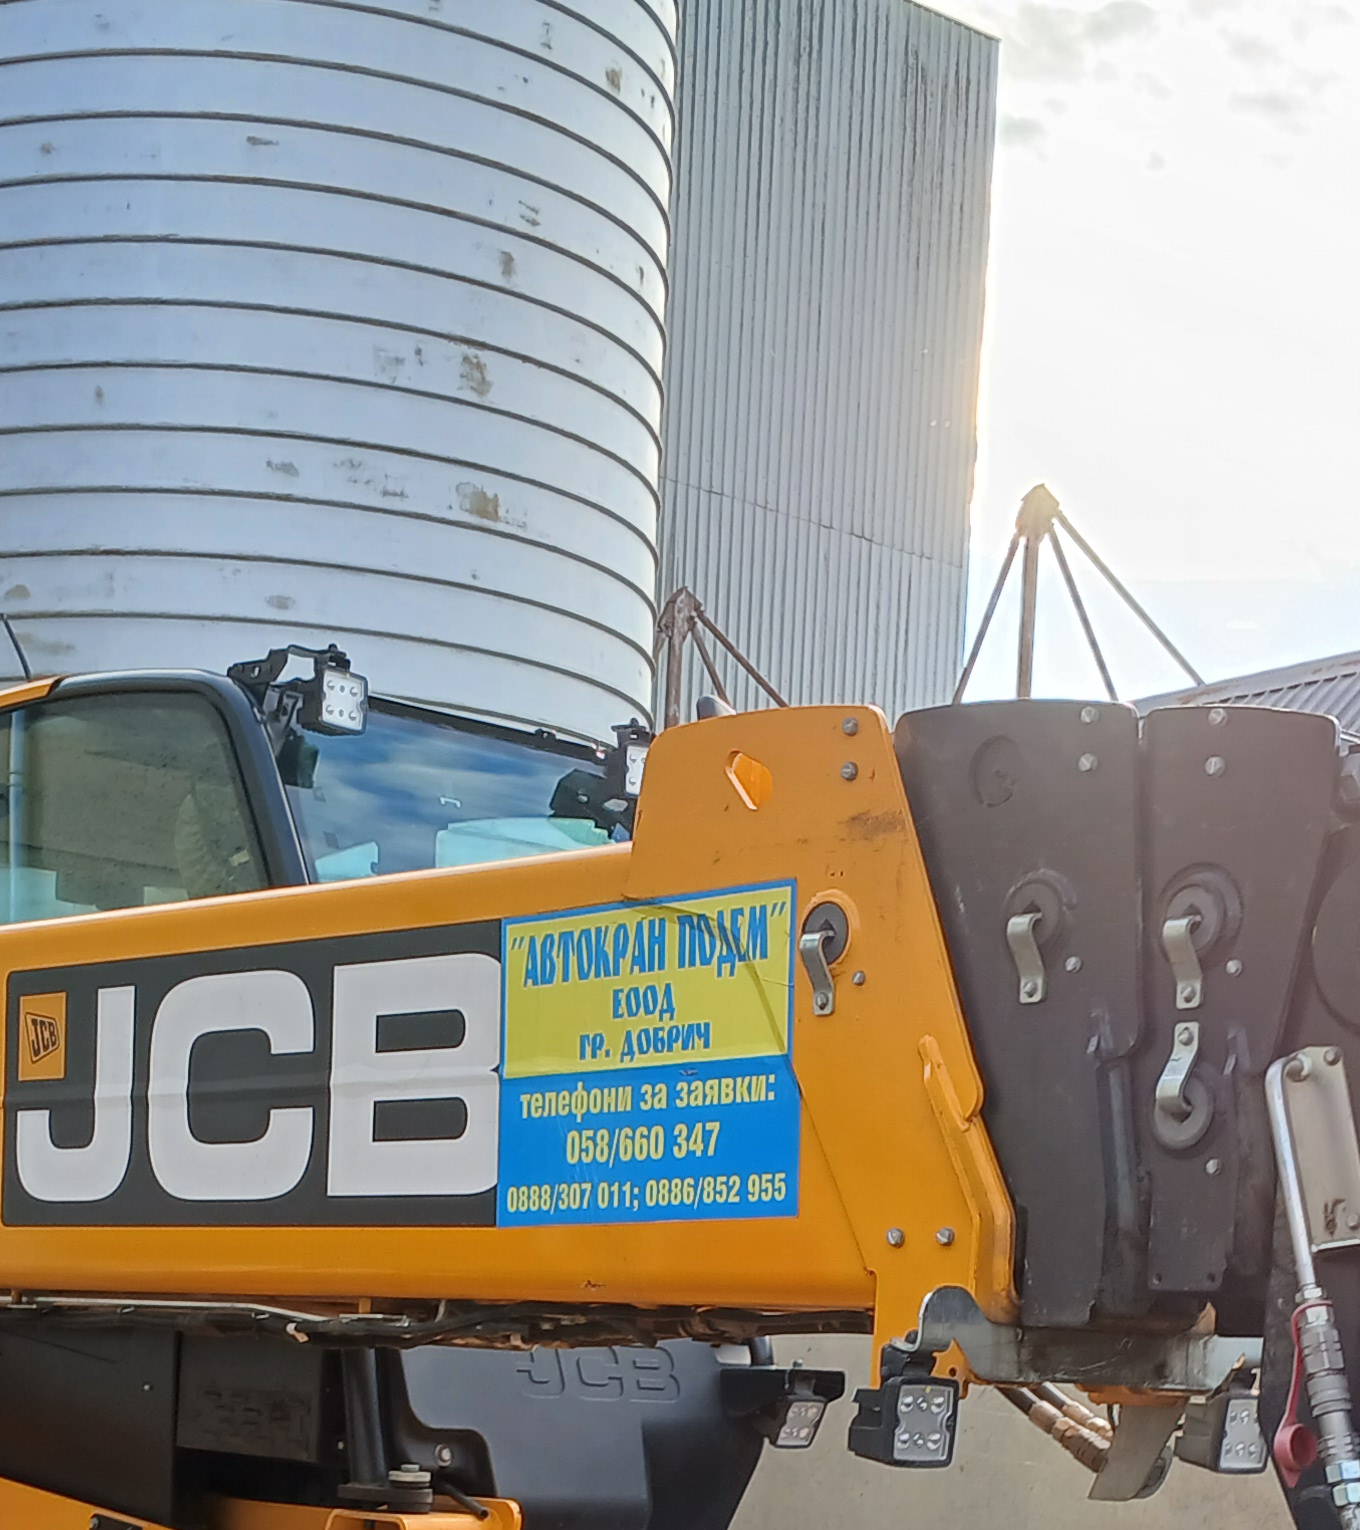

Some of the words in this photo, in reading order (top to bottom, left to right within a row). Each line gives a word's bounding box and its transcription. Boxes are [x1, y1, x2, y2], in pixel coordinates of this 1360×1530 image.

[612, 982, 676, 1022] ЕООД
[30, 1018, 58, 1058] JCB
[579, 1033, 611, 1061] ГР.
[619, 1021, 711, 1063] ДОБРИЧ
[16, 952, 501, 1202] JCB
[520, 1081, 633, 1122] телефони
[640, 1083, 668, 1110] за
[675, 1073, 776, 1108] заявки:
[566, 1125, 665, 1168] 058/660
[673, 1121, 721, 1158] 347
[507, 1182, 592, 1215] 0888/307
[597, 1181, 640, 1211] 011;
[645, 1176, 740, 1210] 0886/852
[747, 1172, 787, 1202] 955
[515, 1346, 681, 1403] JCB
